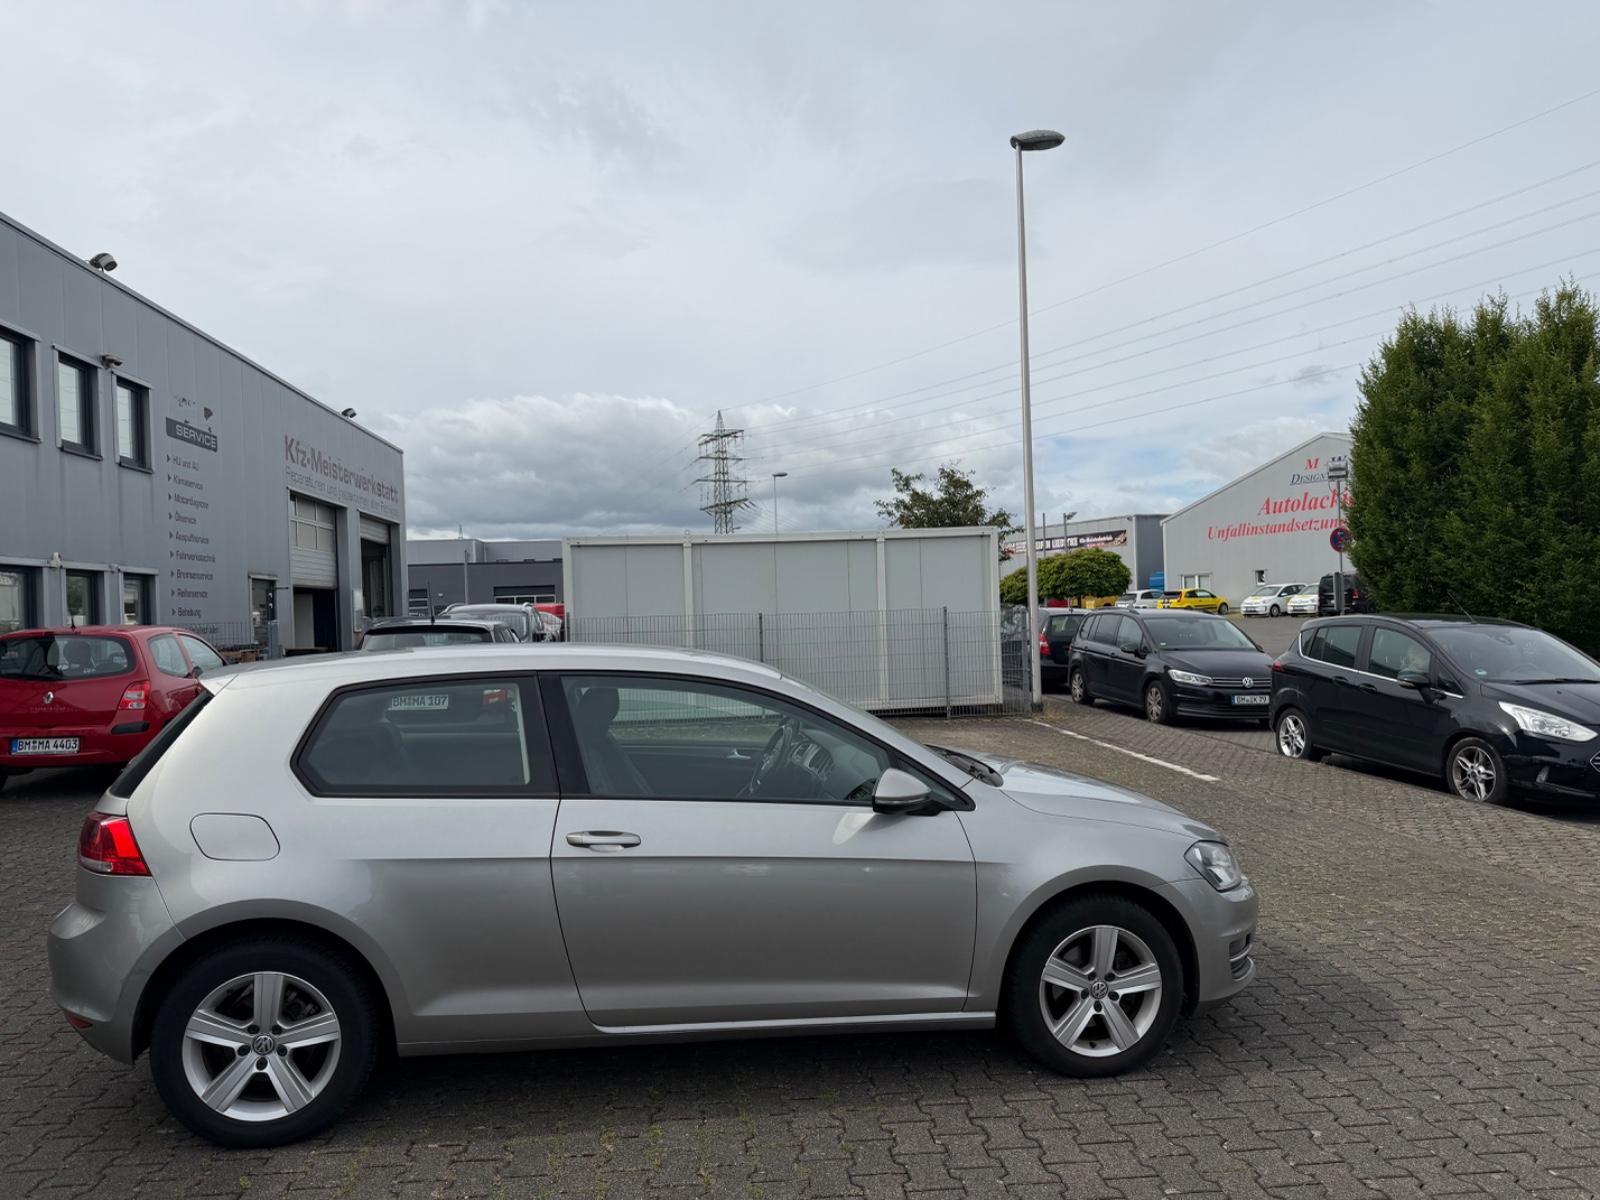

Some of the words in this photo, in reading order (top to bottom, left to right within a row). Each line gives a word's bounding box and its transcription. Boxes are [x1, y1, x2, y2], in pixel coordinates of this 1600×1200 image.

[175, 424, 217, 448] SERVICE
[18, 740, 31, 752] BM
[38, 740, 50, 750] MA
[53, 739, 77, 750] 4403
